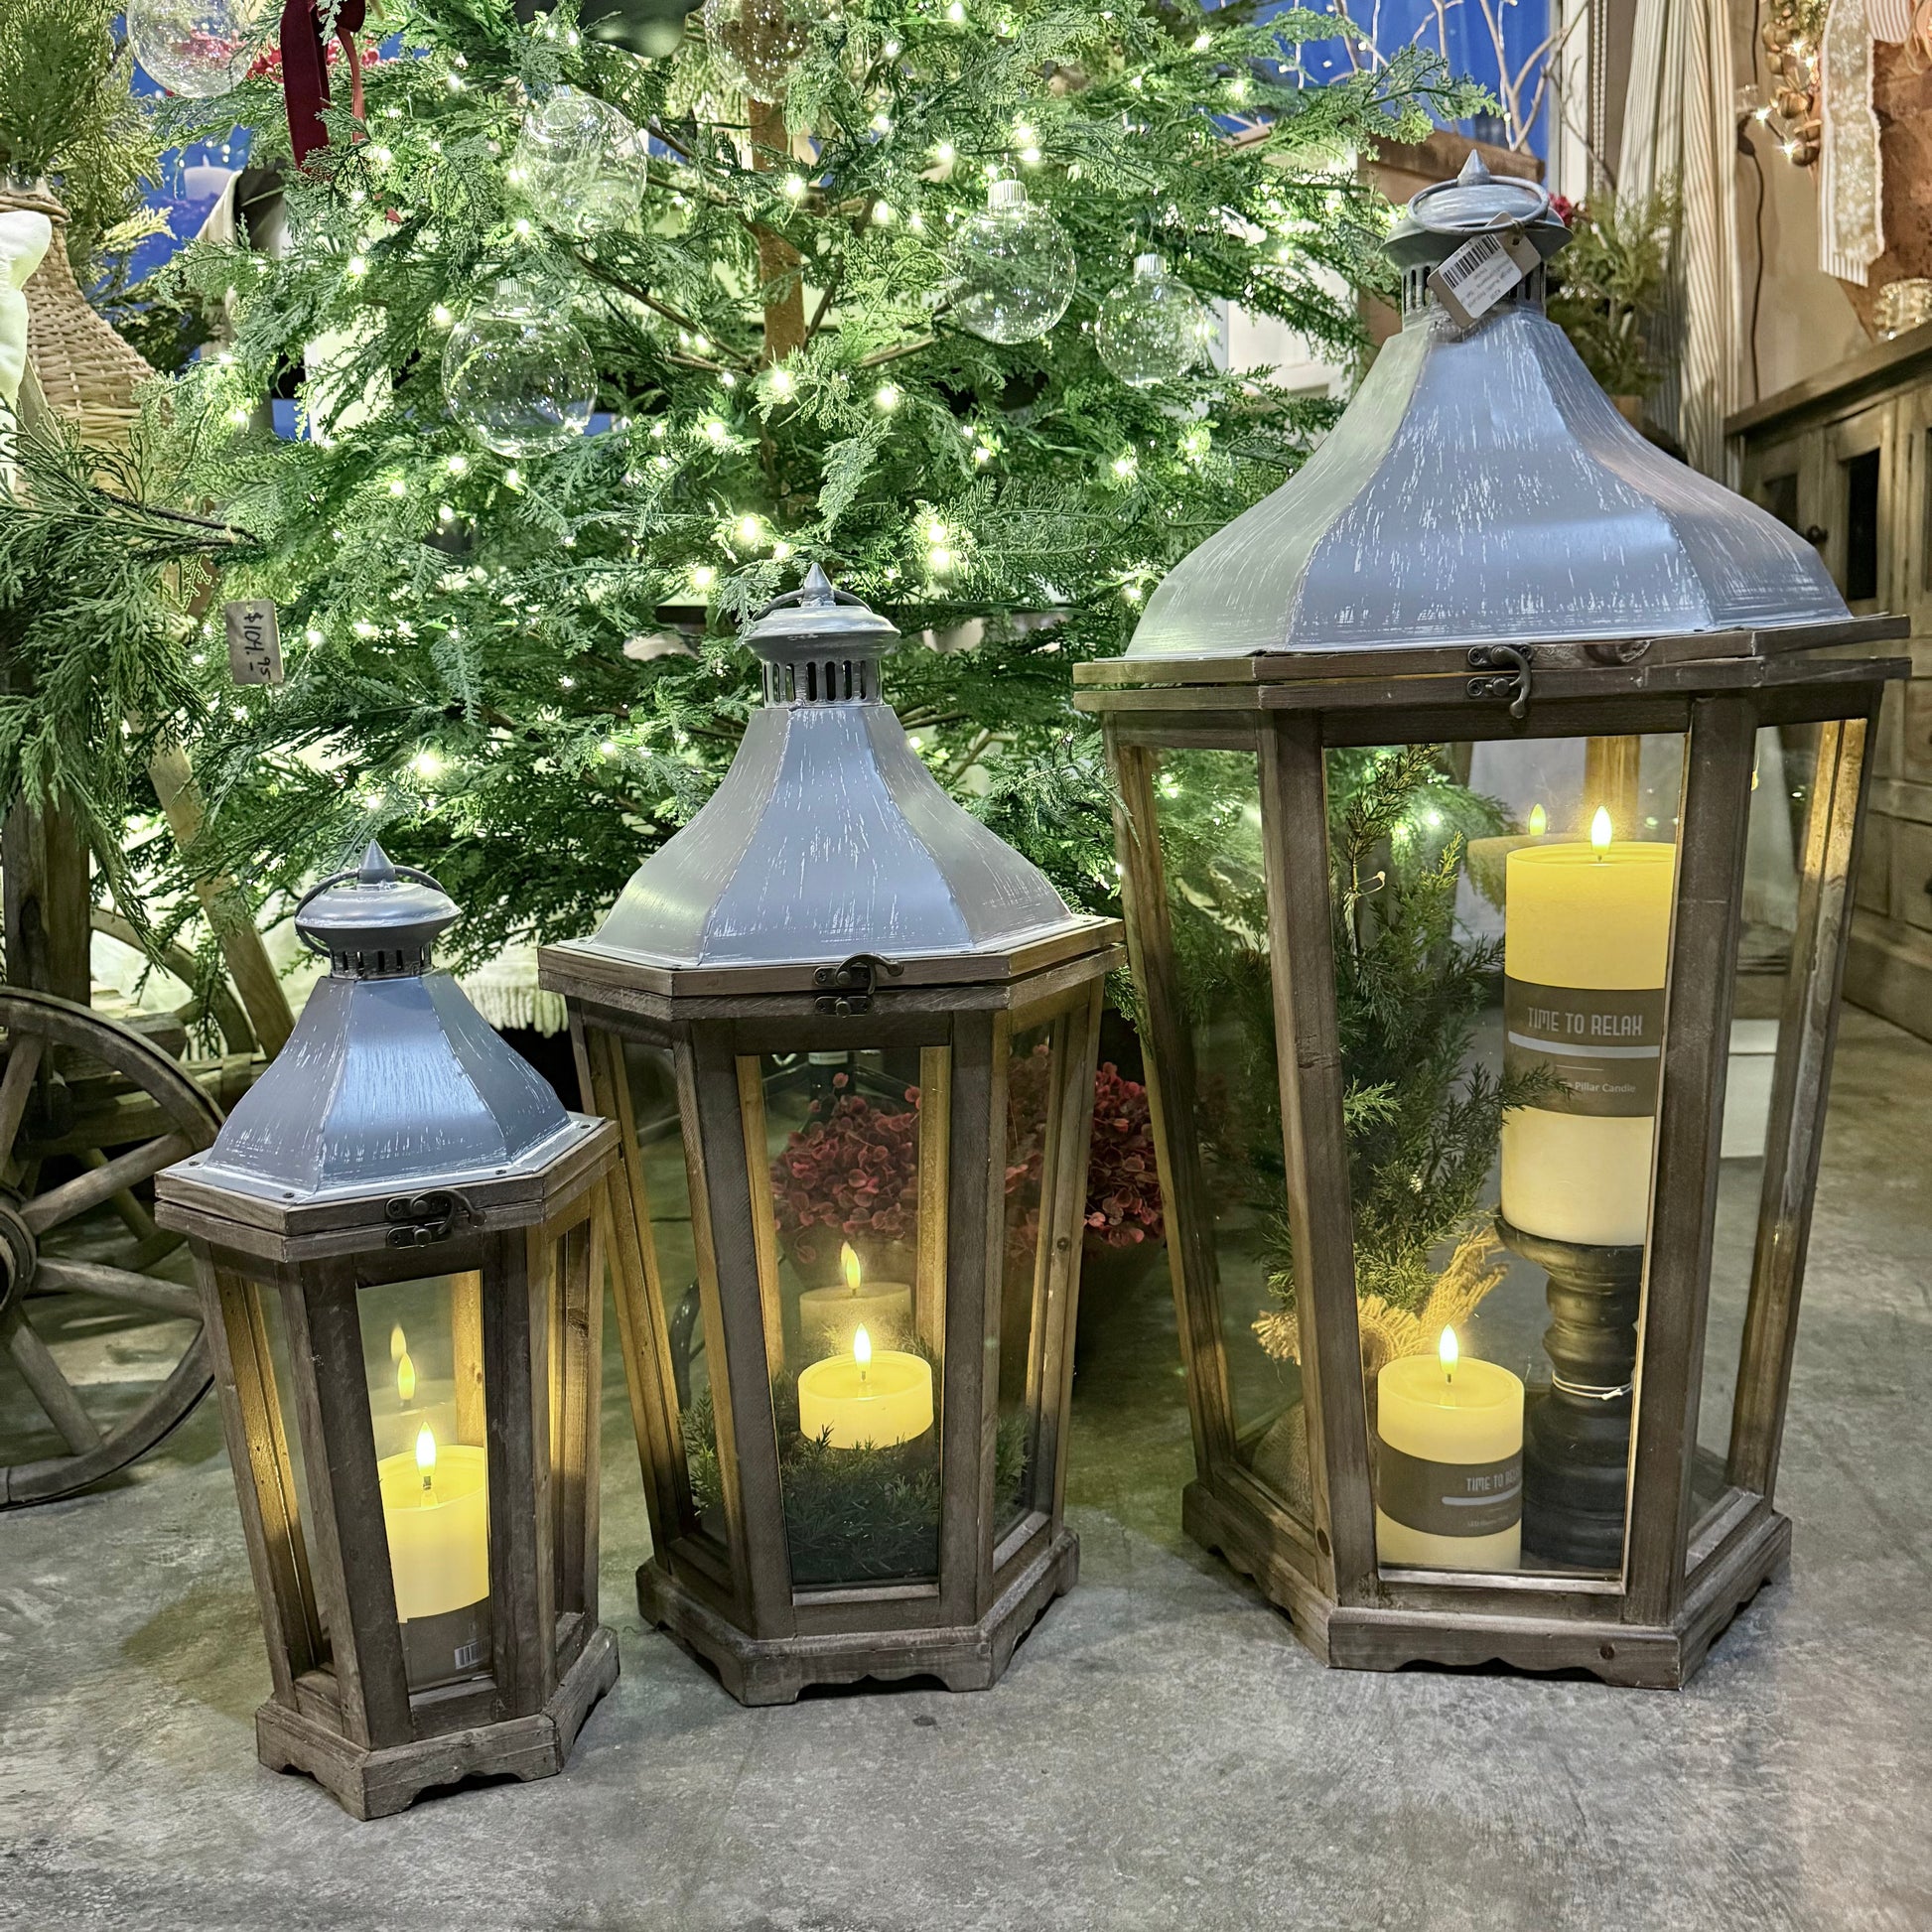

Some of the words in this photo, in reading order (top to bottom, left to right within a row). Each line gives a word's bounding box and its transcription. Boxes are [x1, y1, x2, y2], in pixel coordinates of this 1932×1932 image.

[1528, 1007, 1560, 1033] TIME
[1565, 1013, 1585, 1034] TO
[1590, 1014, 1643, 1036] RELAX
[1575, 1081, 1599, 1092] Pillar
[1601, 1082, 1637, 1093] Candle
[1466, 1476, 1491, 1492] TIME
[1493, 1472, 1504, 1488] TO
